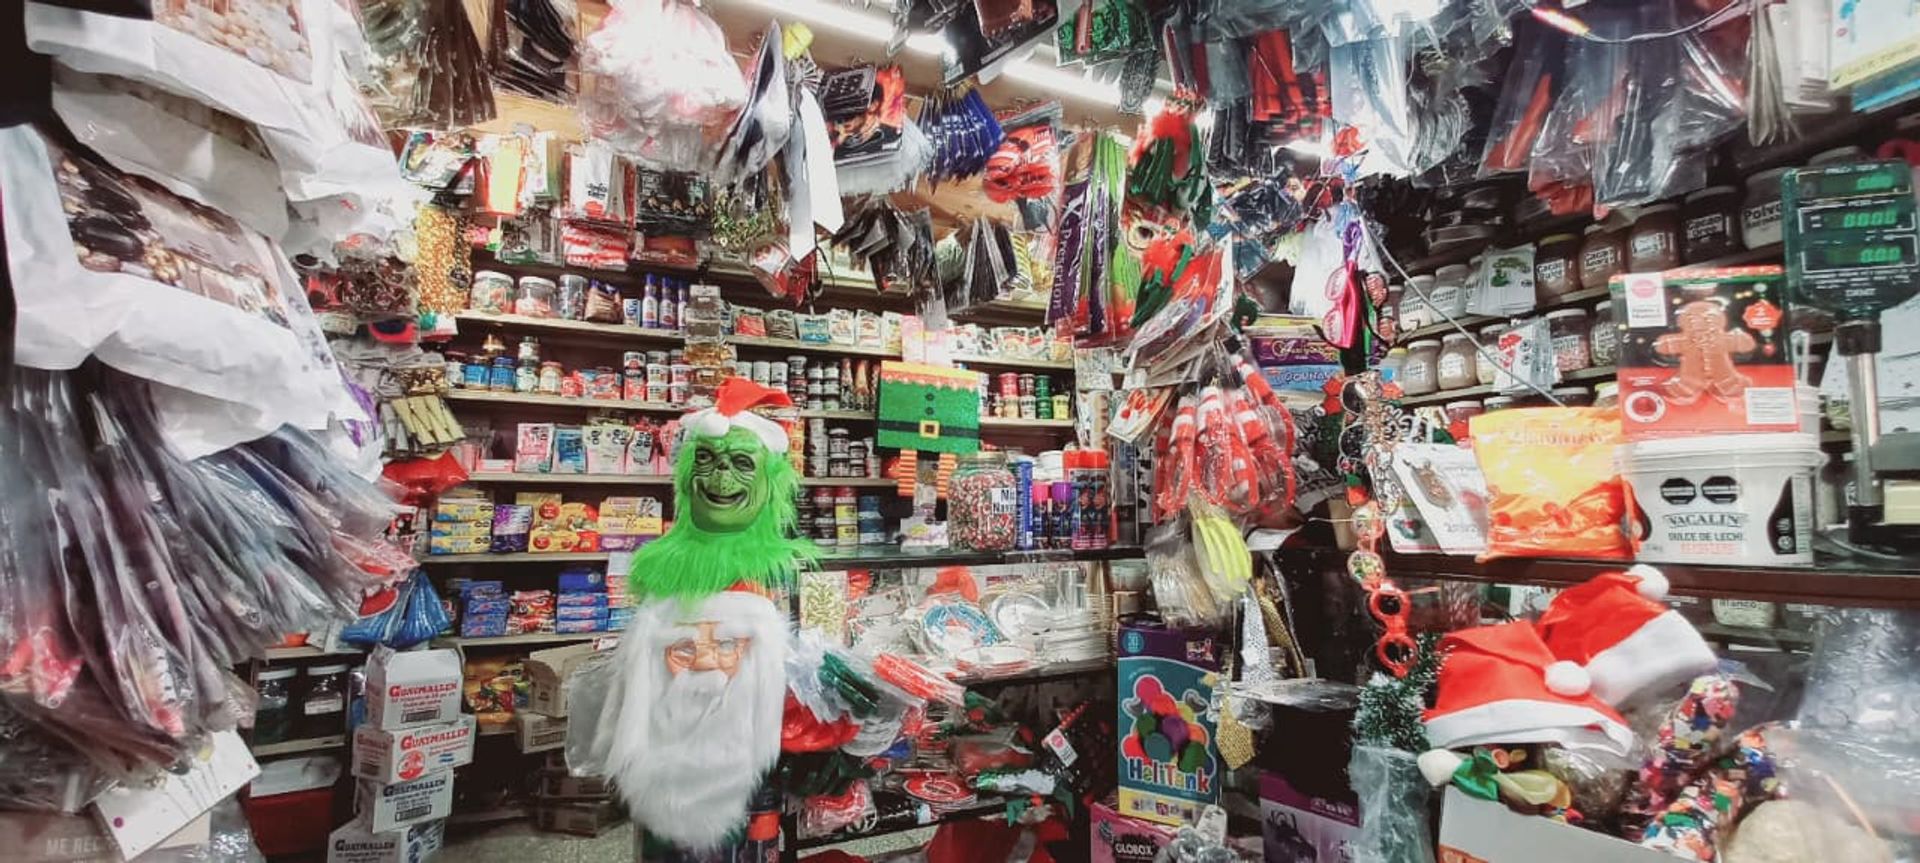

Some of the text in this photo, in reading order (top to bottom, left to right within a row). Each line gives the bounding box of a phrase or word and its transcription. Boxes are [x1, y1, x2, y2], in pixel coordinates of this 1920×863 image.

[1668, 532, 1697, 541] DULCE
[1699, 532, 1712, 541] DE
[1127, 757, 1212, 795] HeliTank
